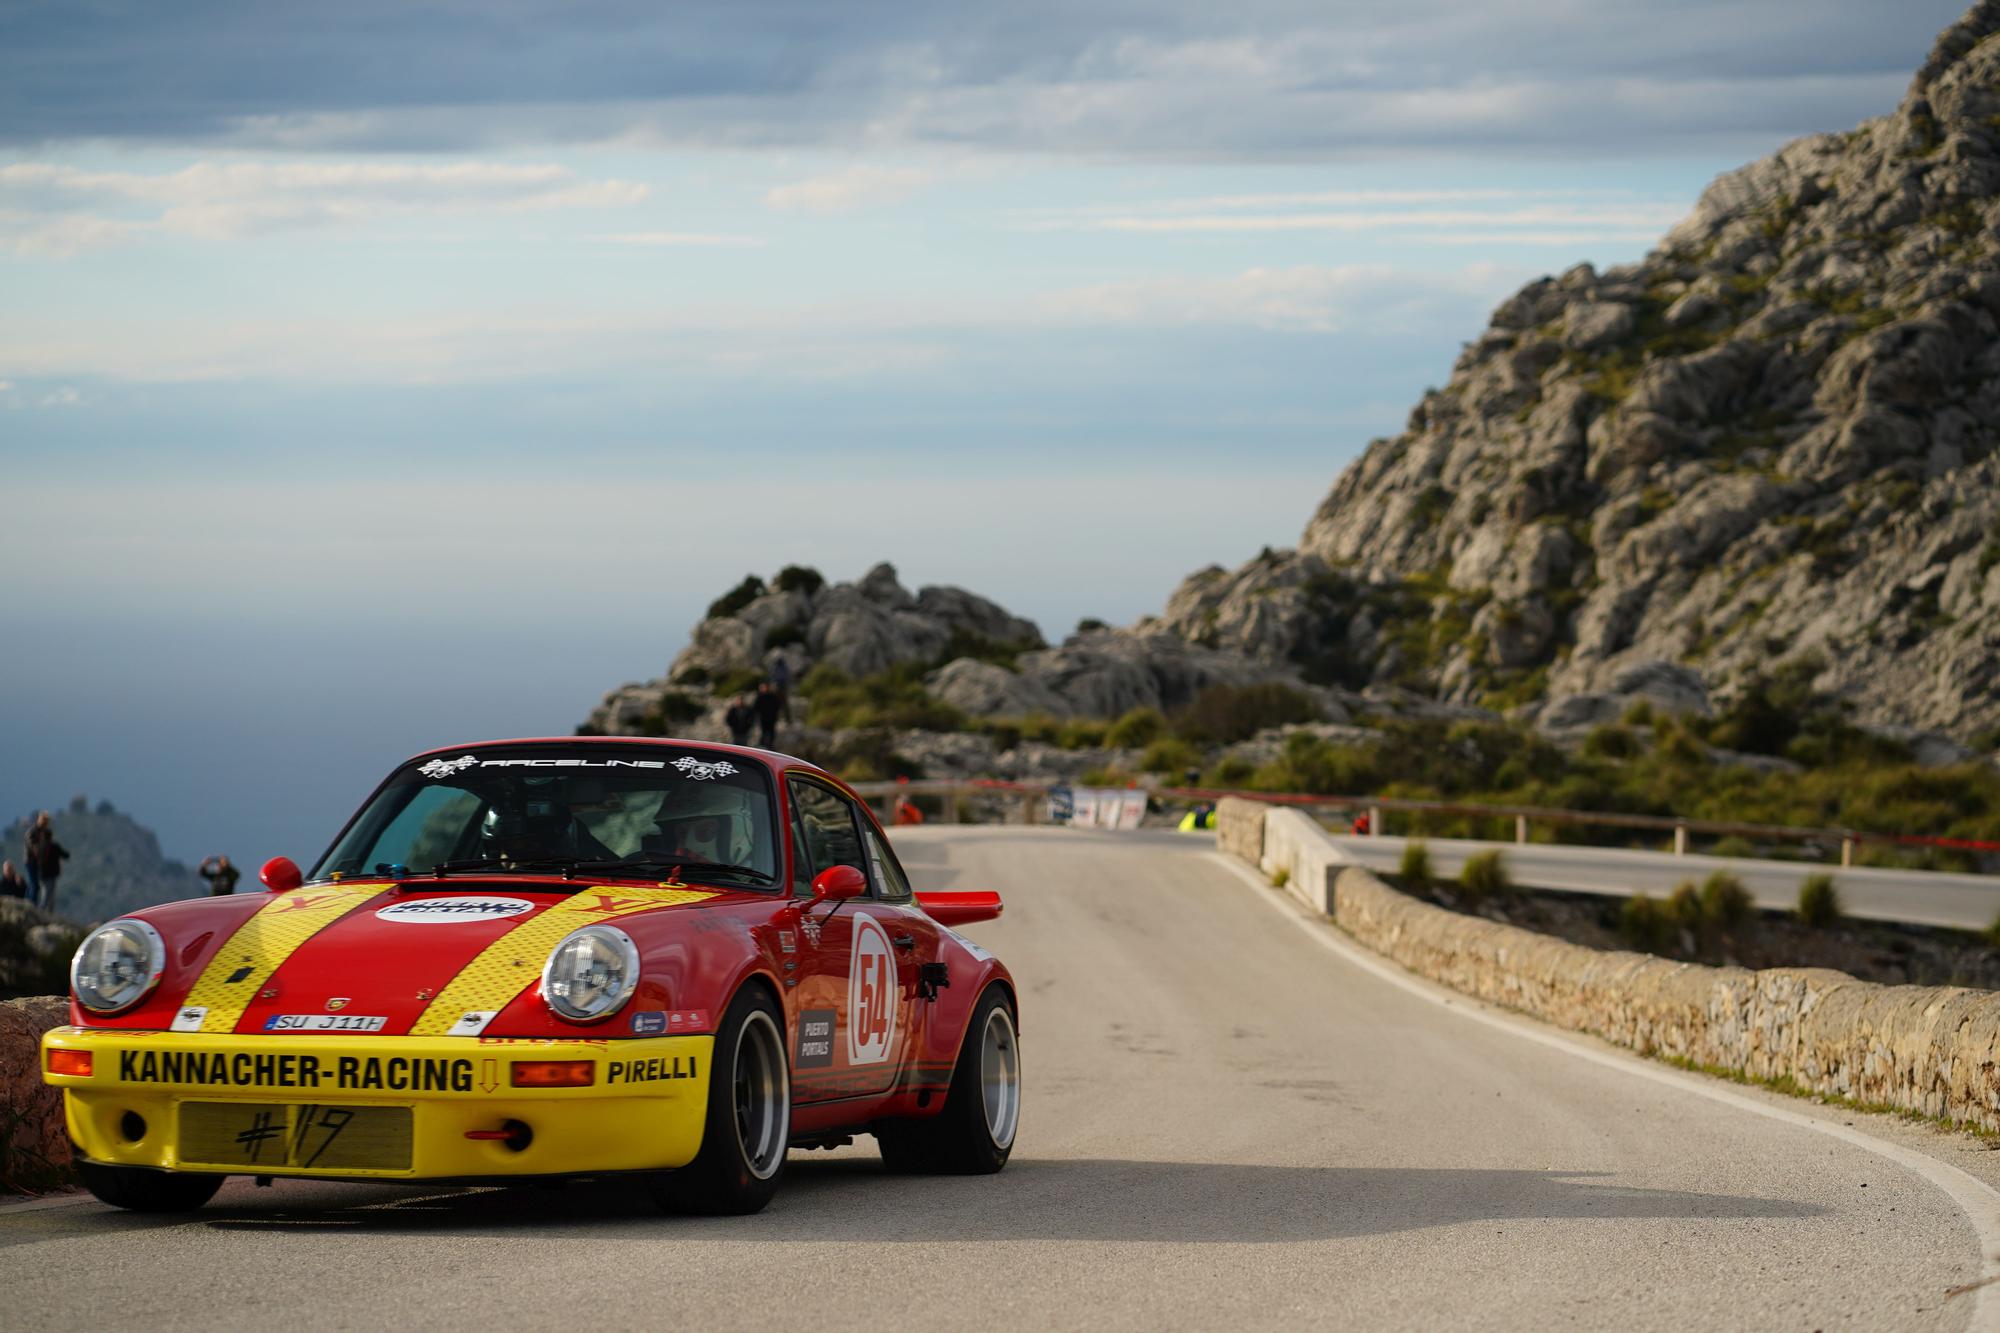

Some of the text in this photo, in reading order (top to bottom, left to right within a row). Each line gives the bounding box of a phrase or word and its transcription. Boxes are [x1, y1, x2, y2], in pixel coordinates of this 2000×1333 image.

[480, 759, 665, 769] RACELINE
[858, 954, 888, 1046] 54
[277, 1016, 309, 1029] SU
[804, 1022, 829, 1037] PUERTO
[801, 1041, 829, 1057] PORTALS
[120, 1050, 473, 1092] KANNACHER-RACING
[607, 1056, 697, 1084] PIRELLI
